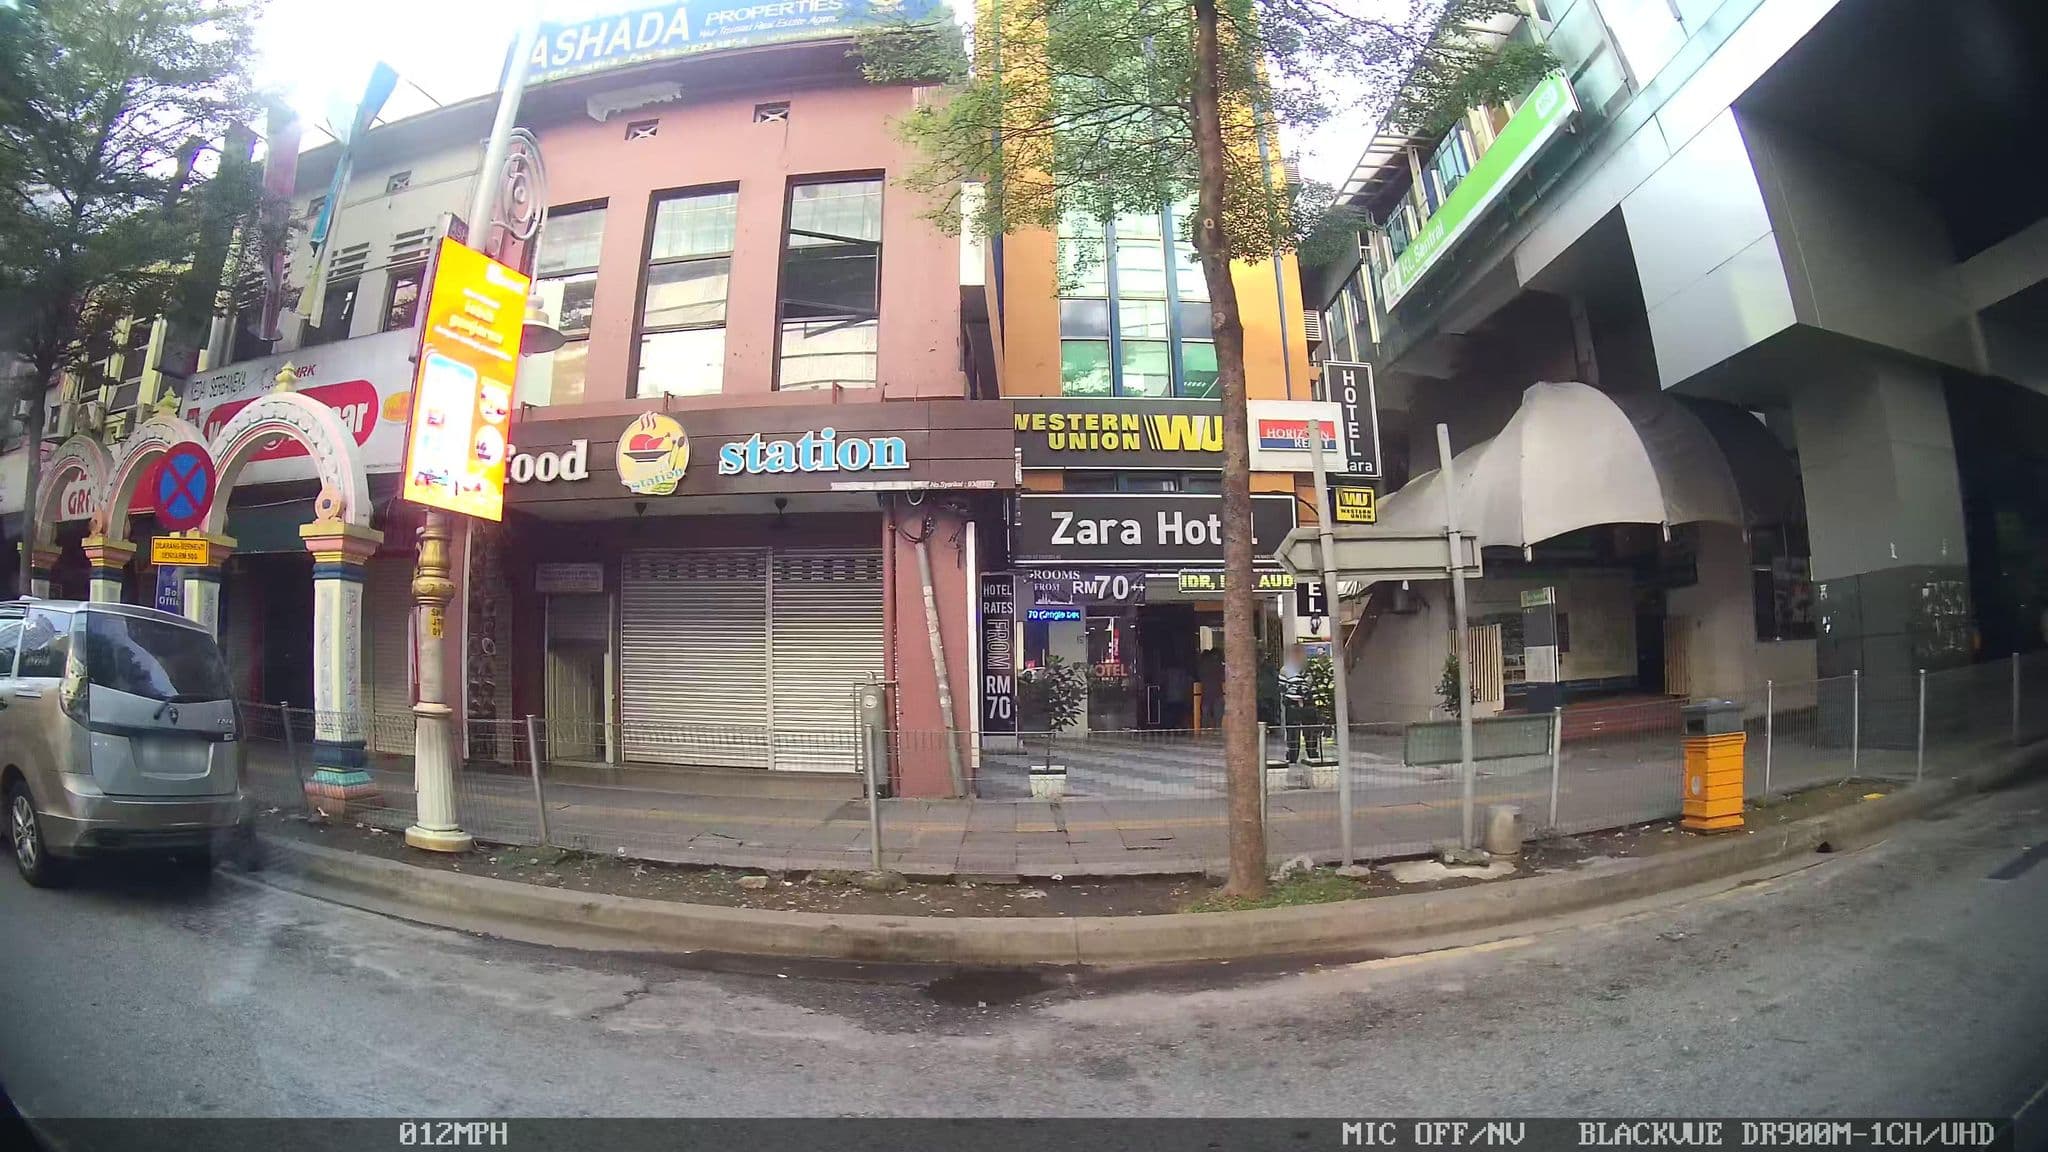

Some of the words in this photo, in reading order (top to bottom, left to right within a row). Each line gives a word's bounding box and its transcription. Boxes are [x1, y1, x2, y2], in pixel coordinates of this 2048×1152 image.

[705, 0, 843, 26] PROPERTIES
[1014, 413, 1140, 431] WESTERN
[1341, 369, 1362, 457] HOTEL
[1048, 432, 1141, 451] UNION
[1294, 438, 1329, 449] RET
[718, 427, 910, 475] station
[1347, 461, 1373, 472] ara
[1341, 493, 1369, 507] WU
[1051, 511, 1142, 545] Zara
[1034, 570, 1081, 580] ROOMS
[983, 583, 1013, 596] HOTEL
[1034, 583, 1061, 591] FROM
[983, 602, 1014, 615] RATES
[986, 619, 1009, 670] FROM
[1094, 664, 1128, 677] OTEL
[986, 675, 1011, 694] RM
[986, 696, 1011, 719] 70
